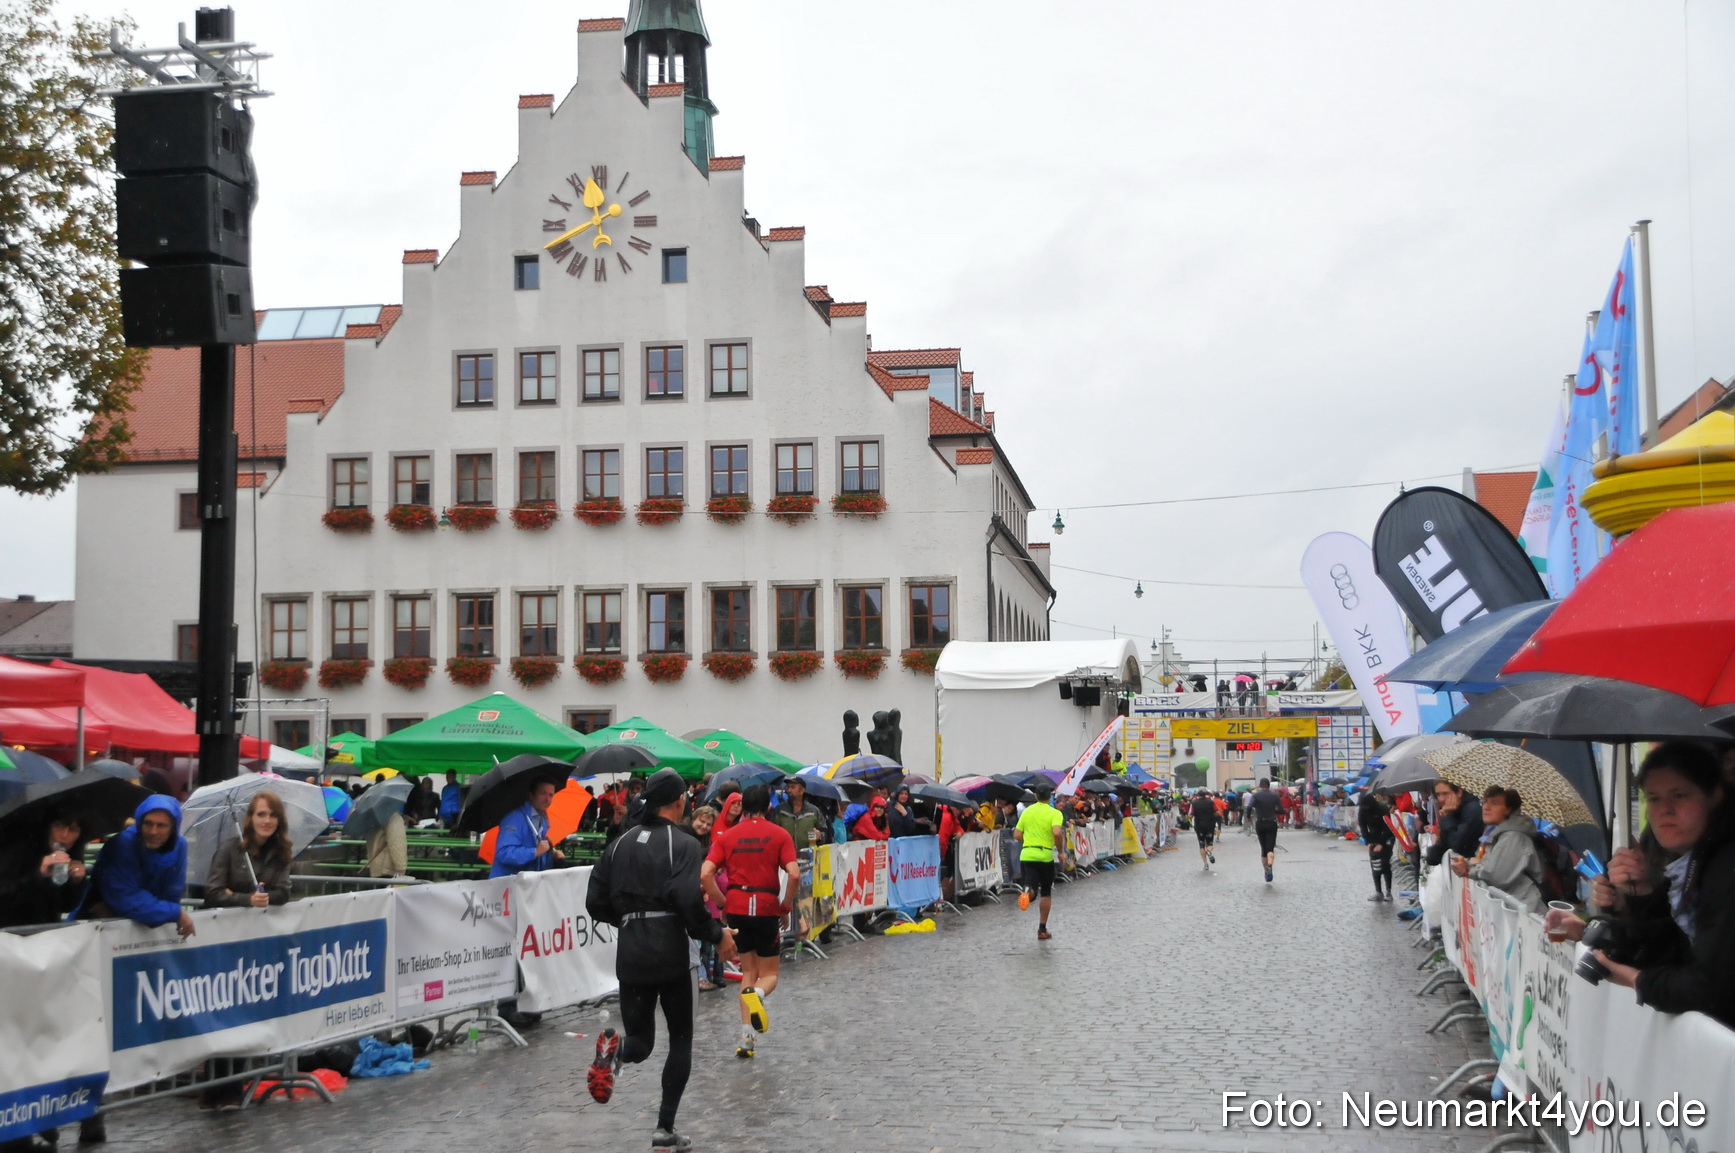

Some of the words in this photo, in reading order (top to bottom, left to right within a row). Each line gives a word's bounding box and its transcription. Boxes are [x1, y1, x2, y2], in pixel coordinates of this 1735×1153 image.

[1134, 696, 1180, 706] BOCK
[1279, 694, 1326, 705] BOCK
[1227, 722, 1260, 735] ZIEL
[520, 917, 573, 960] Audi
[398, 958, 410, 975] Ihr
[411, 950, 461, 973] Telekom-Shop
[464, 948, 472, 964] 2x
[474, 946, 481, 961] in
[482, 942, 512, 961] Neumarkt
[136, 956, 285, 1024] Neumarkter
[288, 939, 372, 997] Tagblatt
[326, 1009, 347, 1027] Hier
[348, 1003, 370, 1021] lebe
